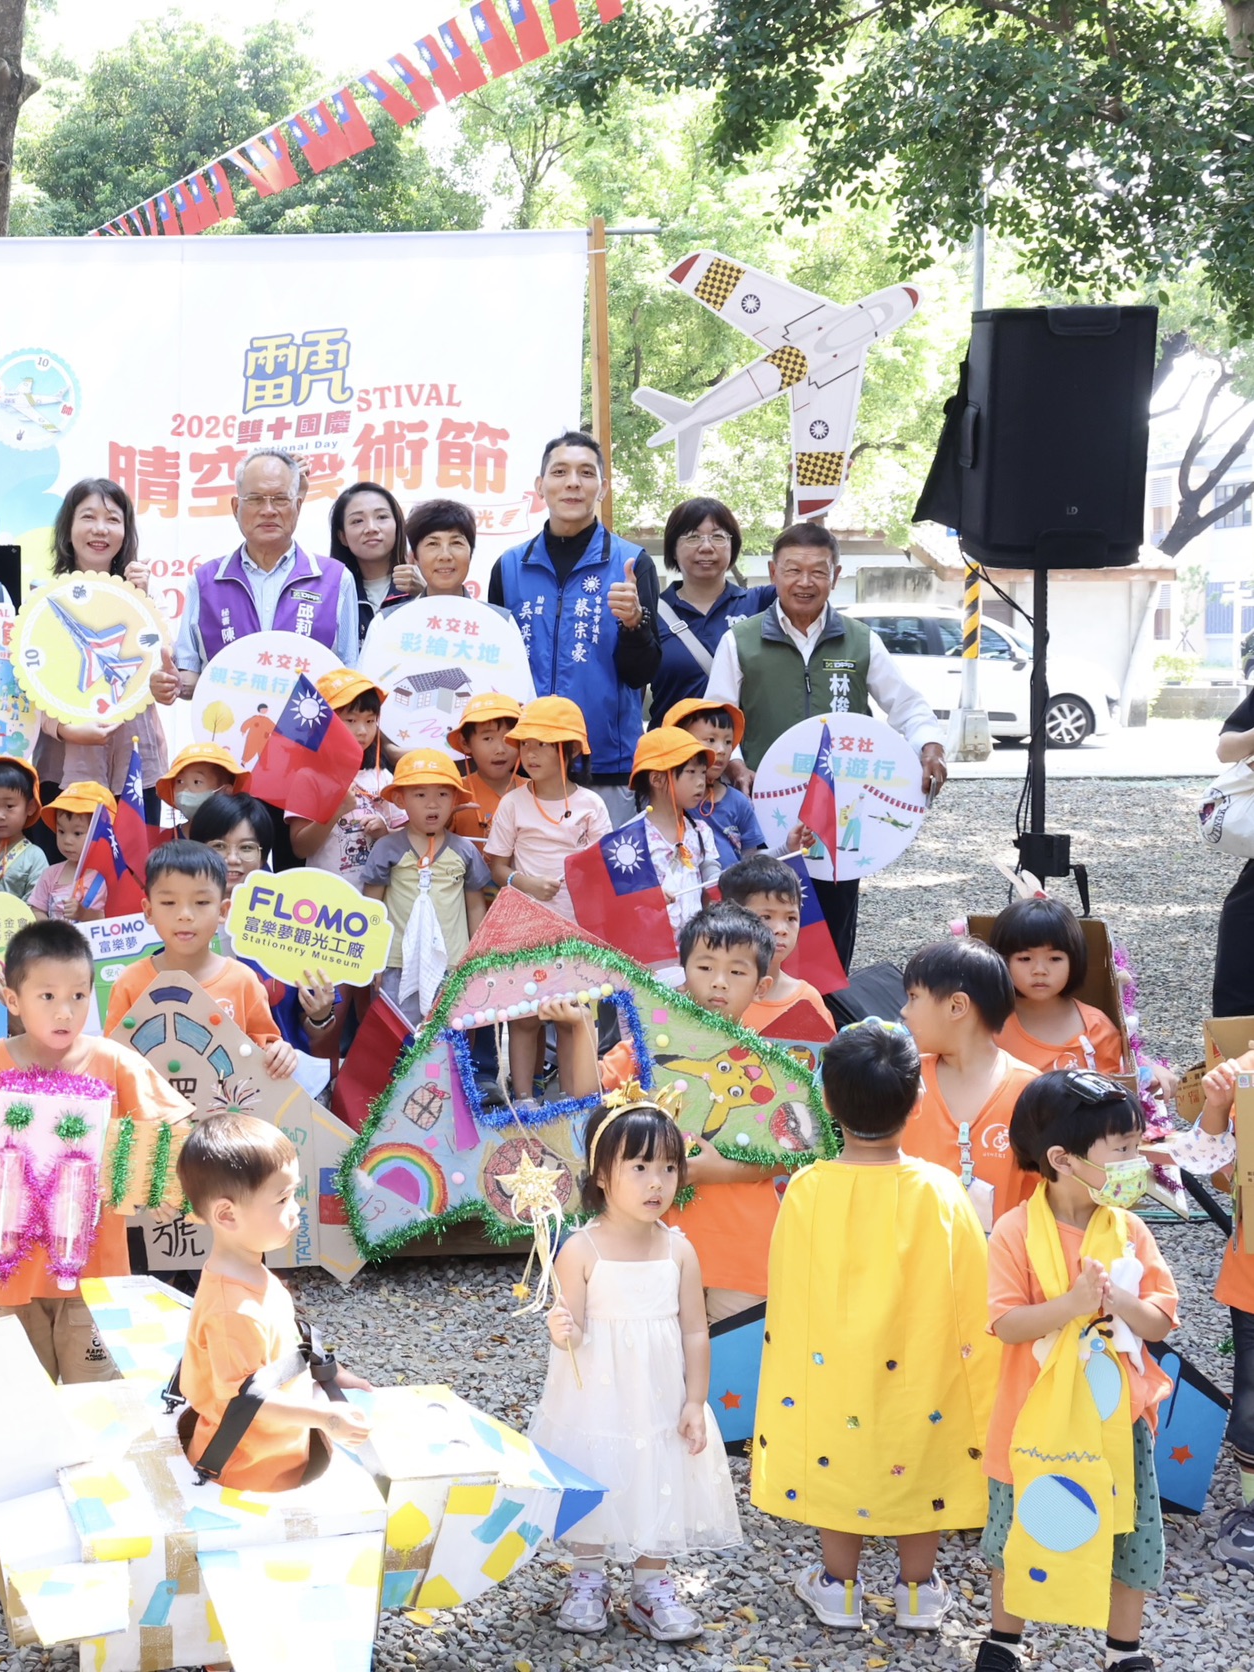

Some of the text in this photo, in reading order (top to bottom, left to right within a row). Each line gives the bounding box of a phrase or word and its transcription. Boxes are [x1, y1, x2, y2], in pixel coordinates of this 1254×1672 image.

[37, 357, 49, 367] 10
[169, 383, 462, 440] 2026 STIVAL
[236, 410, 351, 444] 雙十國慶
[315, 440, 339, 452] Day
[149, 555, 203, 578] 026
[72, 584, 88, 600] 象
[534, 595, 545, 615] 助理
[295, 603, 315, 637] 邱莉
[426, 615, 480, 636] 水交社
[571, 597, 593, 662] 蔡宗豪
[591, 595, 603, 645] 台南市議員
[221, 626, 236, 644] 陳
[25, 649, 40, 668] 10
[400, 632, 501, 664] 彩繪大地
[257, 651, 311, 673] 水交社
[209, 665, 297, 695] 親子飛行
[831, 736, 874, 753] 交社
[248, 886, 369, 938] FLOMO
[90, 920, 144, 939] FLOMO
[244, 915, 366, 960] 富樂夢觀光工廠
[98, 937, 138, 954] 富樂夢
[242, 933, 360, 969] Stationery Museum
[152, 1213, 205, 1257] 號
